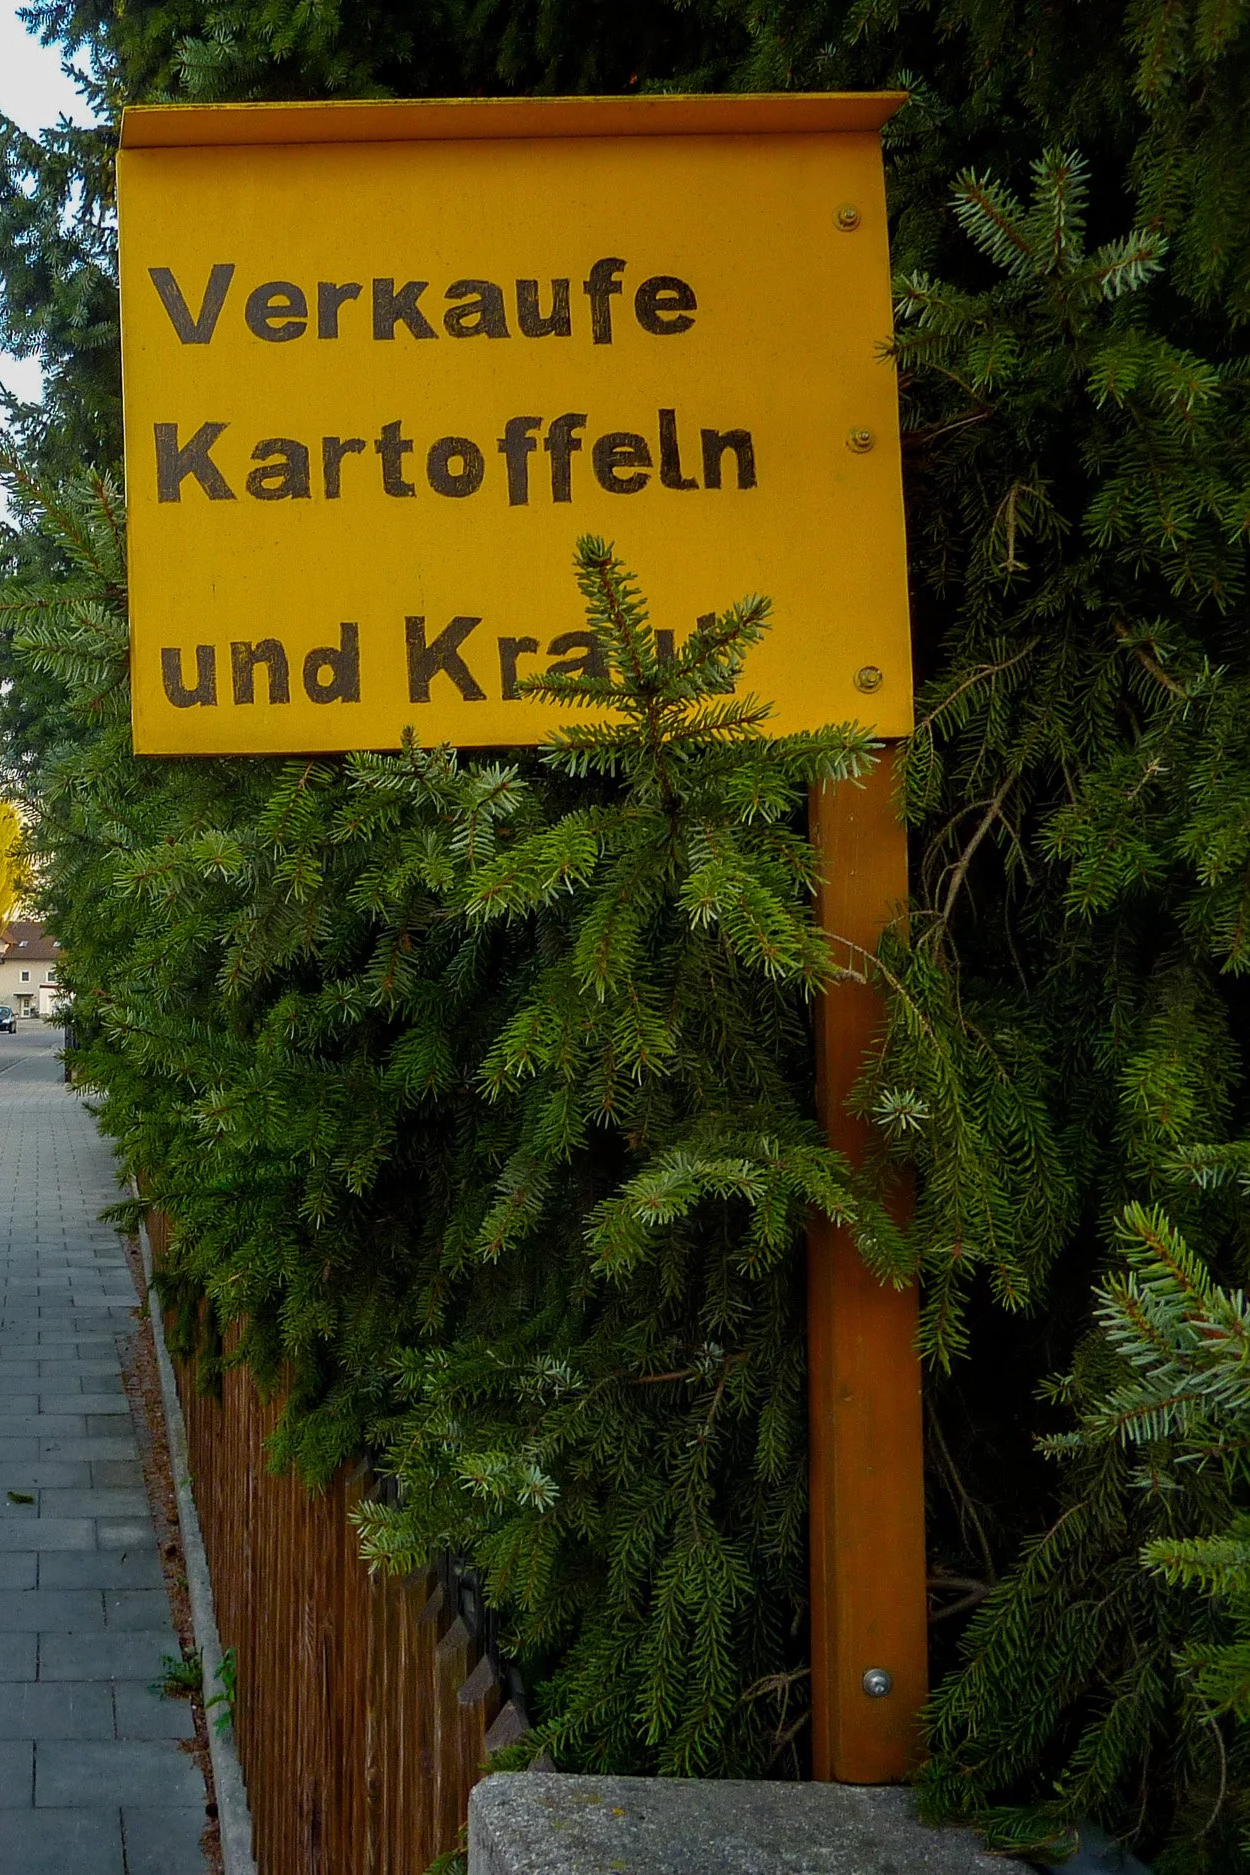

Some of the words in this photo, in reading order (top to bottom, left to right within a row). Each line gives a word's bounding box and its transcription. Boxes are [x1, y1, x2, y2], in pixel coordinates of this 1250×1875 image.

[149, 257, 698, 346] Verkaufe
[153, 408, 758, 507] Kartoffeln
[161, 621, 361, 708] und
[405, 614, 738, 706] Kra
